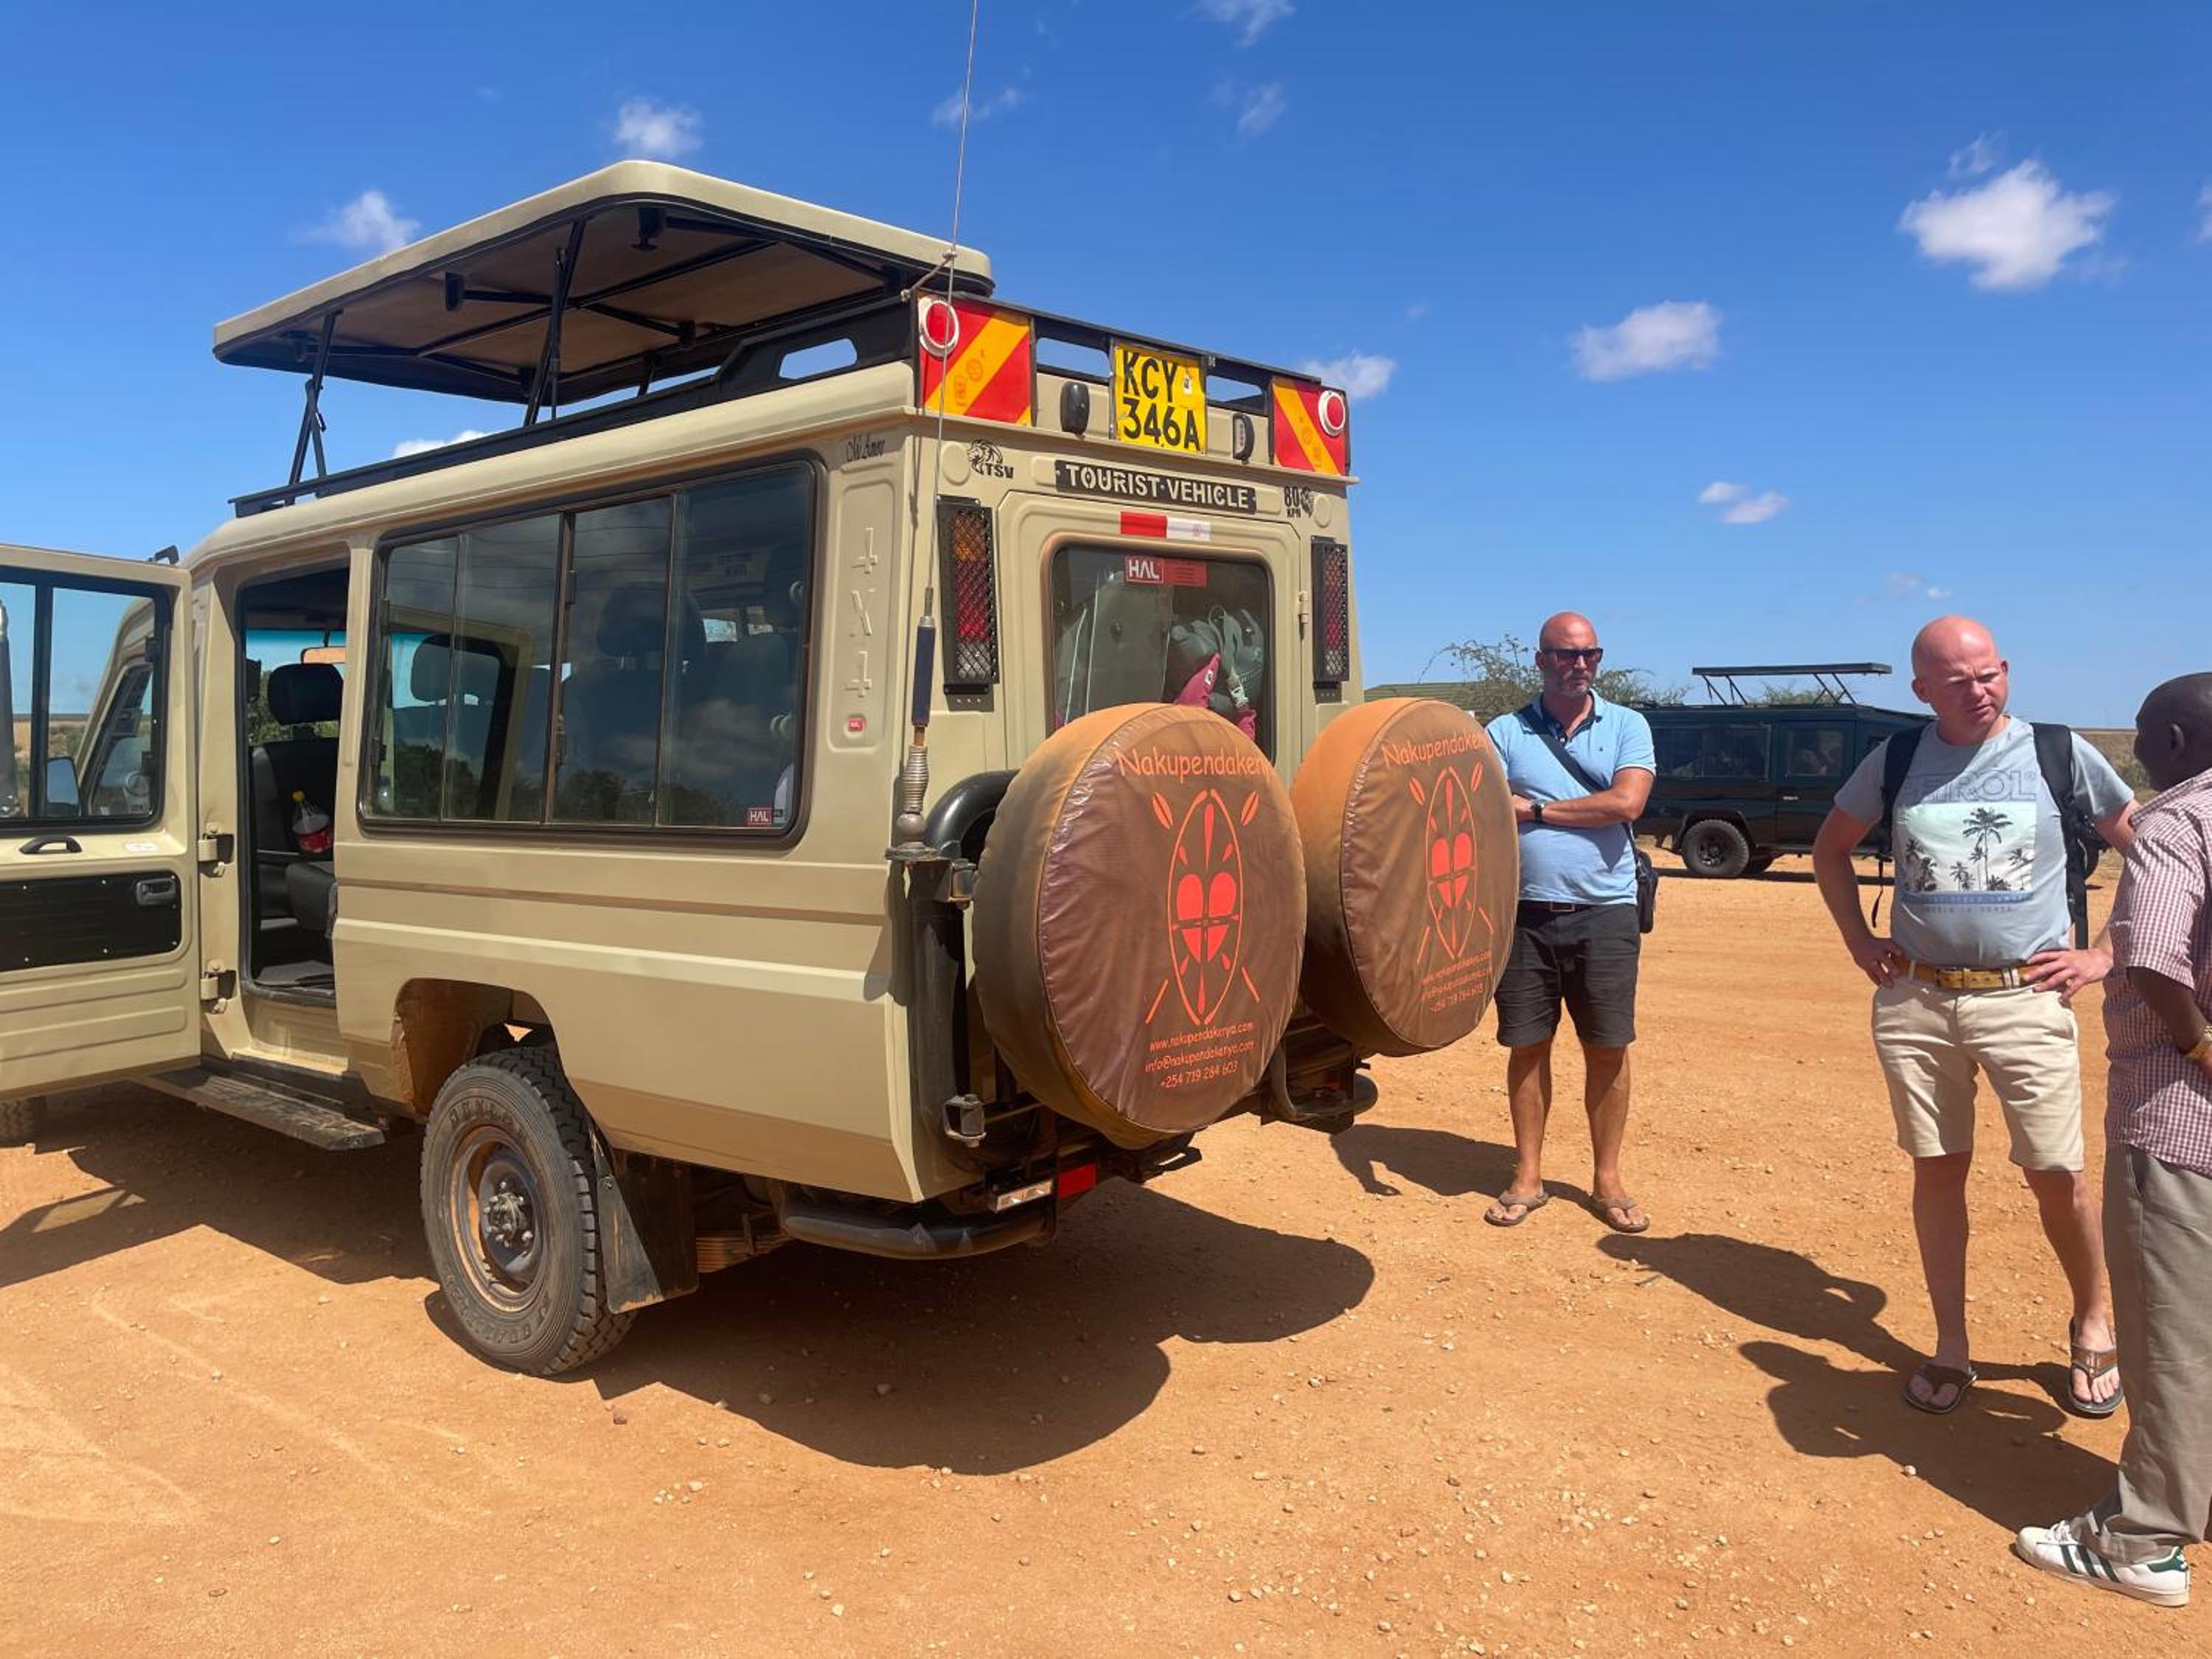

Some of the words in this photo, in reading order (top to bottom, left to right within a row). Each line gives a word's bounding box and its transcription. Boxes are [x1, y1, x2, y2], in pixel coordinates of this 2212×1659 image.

[1123, 349, 1178, 403] KCY
[1123, 396, 1202, 451] 346A
[1065, 464, 1161, 498] TOURIST
[1166, 479, 1249, 509] VEHICLE
[1284, 485, 1300, 507] 80
[1128, 558, 1160, 580] HAL
[749, 810, 770, 823] HAL
[1185, 1068, 1202, 1084] 719
